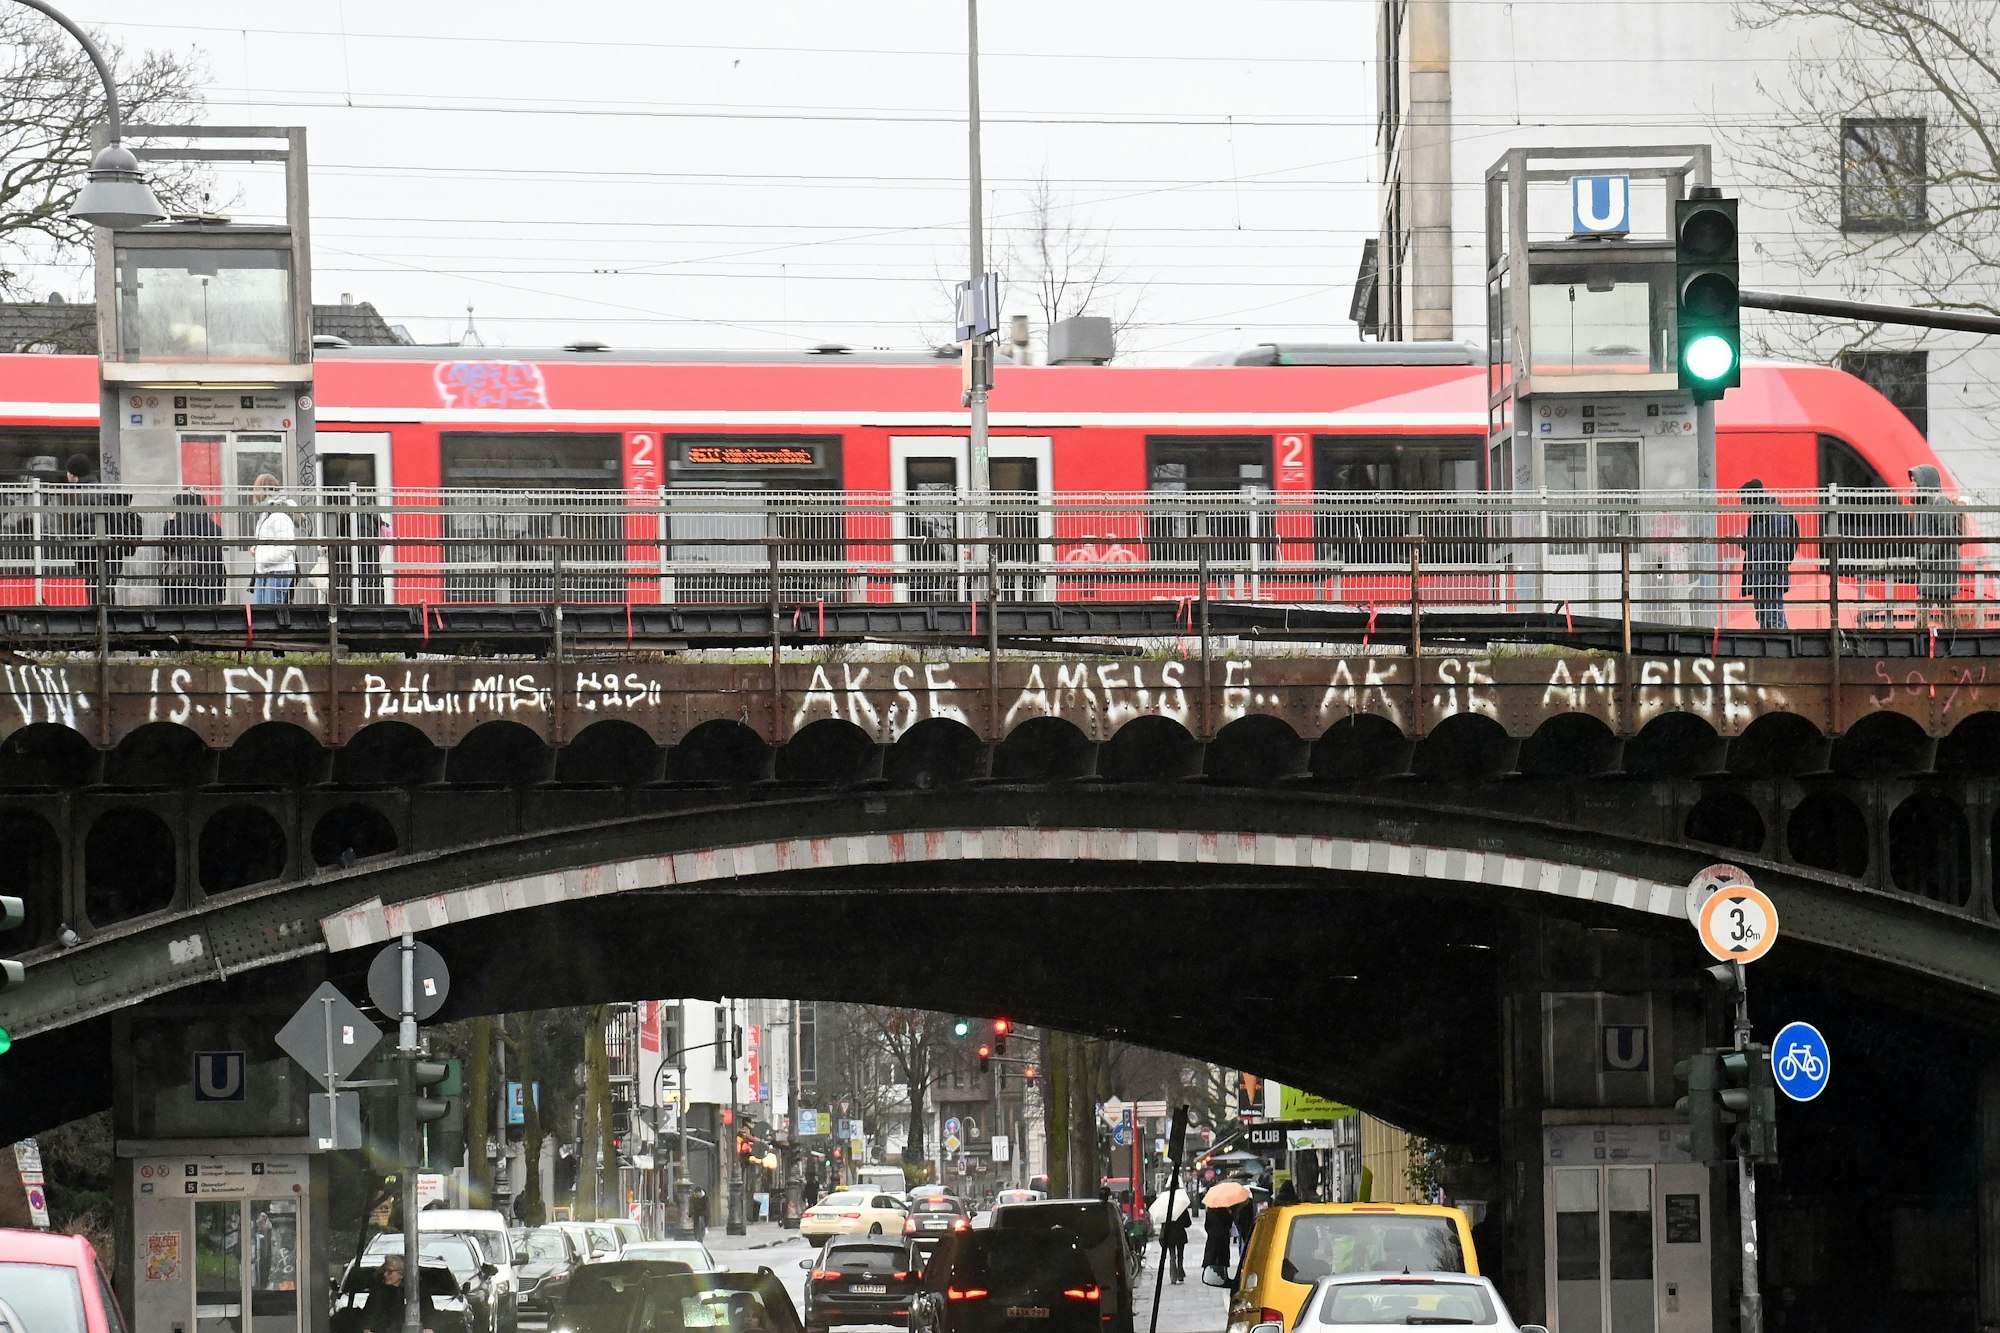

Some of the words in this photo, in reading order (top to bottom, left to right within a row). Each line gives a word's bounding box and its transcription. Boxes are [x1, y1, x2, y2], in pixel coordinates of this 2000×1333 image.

[1577, 178, 1625, 231] U
[631, 434, 654, 466] 2
[1281, 436, 1304, 467] 2
[1605, 1028, 1645, 1070] U
[200, 1055, 240, 1098] U
[1252, 1130, 1280, 1143] CLUB
